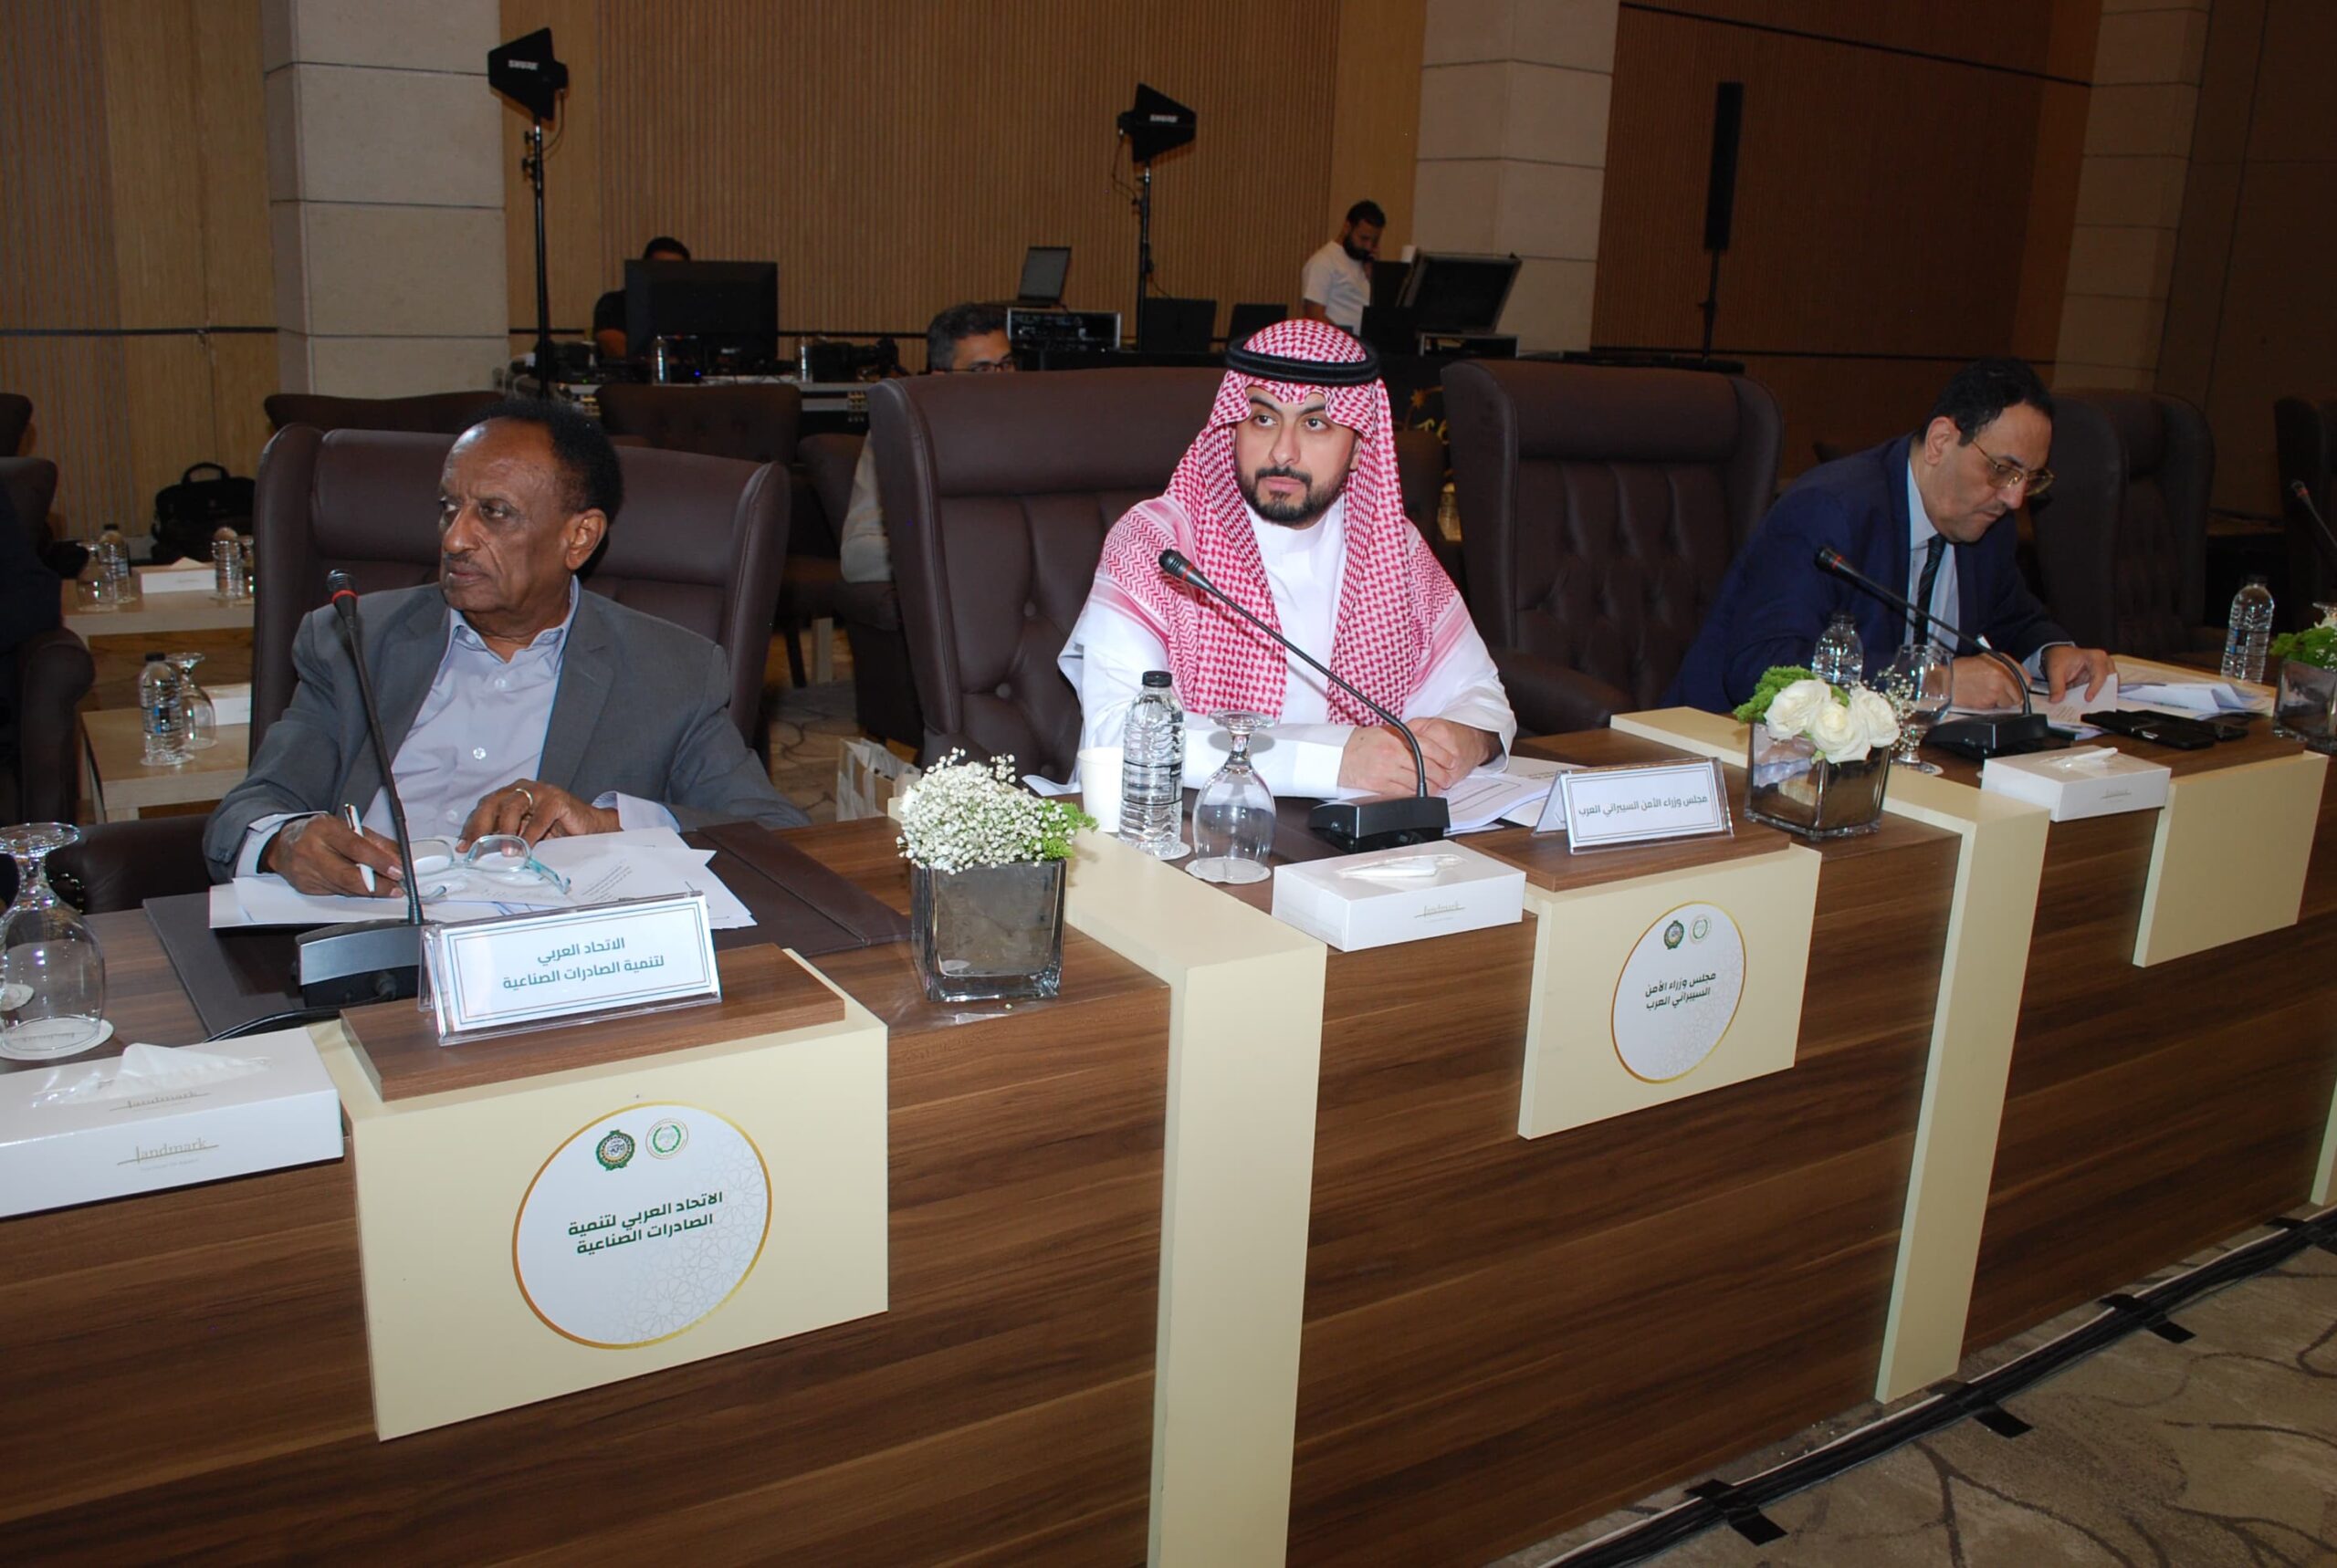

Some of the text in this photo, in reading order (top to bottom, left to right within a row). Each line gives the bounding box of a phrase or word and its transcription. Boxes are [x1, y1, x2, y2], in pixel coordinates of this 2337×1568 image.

[1578, 795, 1708, 818] مجلس وزراء الأمن السيبراني العرب
[537, 936, 625, 966] الاتحاد العربي
[503, 955, 665, 991] لتنمية الصادرات الصناعية
[1645, 972, 1716, 998] مجلس وزراء الأمن
[1646, 987, 1711, 1012] السيبراني العرب
[134, 1136, 206, 1165] landmark
[568, 1191, 723, 1238] الاتحاد العربي لتنمية
[577, 1213, 713, 1256] الصادرات الصناعية
